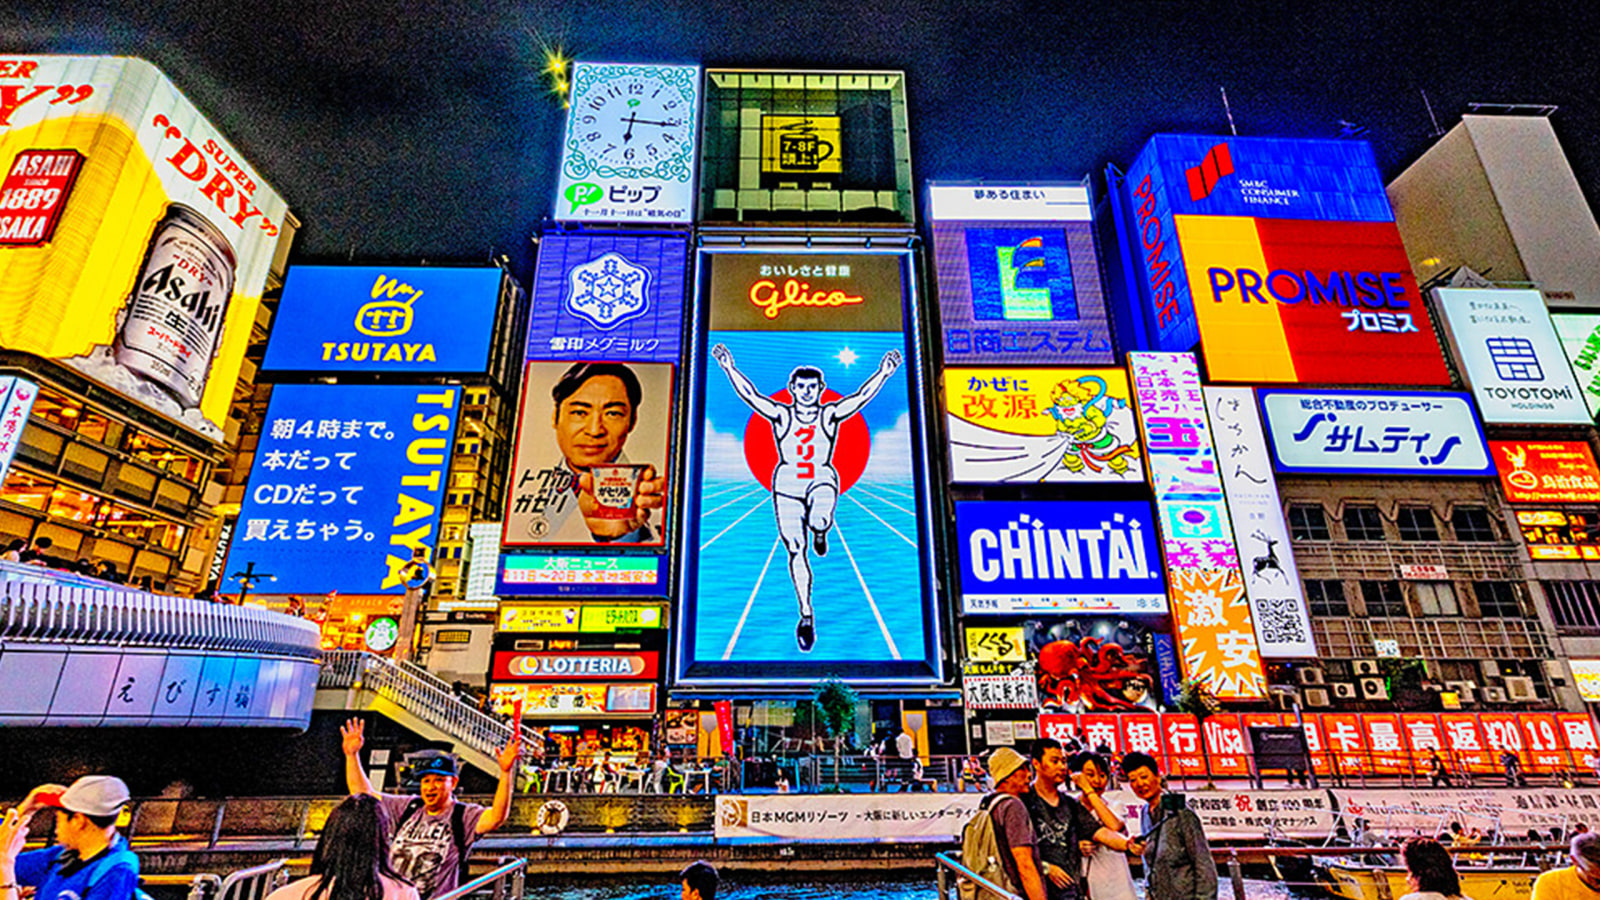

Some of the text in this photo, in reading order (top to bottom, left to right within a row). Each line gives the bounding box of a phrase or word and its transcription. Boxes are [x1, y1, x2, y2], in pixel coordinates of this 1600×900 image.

[607, 86, 622, 99] 11
[629, 84, 644, 95] 12
[588, 96, 606, 111] 10
[582, 115, 596, 124] 9
[586, 131, 602, 142] 8
[603, 143, 616, 154] 7
[623, 148, 635, 160] 6
[646, 143, 658, 156] 5
[782, 140, 817, 152] 7-8F
[11, 155, 76, 176] ASAHI
[203, 138, 258, 197] SUPER
[609, 185, 662, 204] ピップ
[1239, 180, 1269, 192] SMBC
[1240, 188, 1301, 199] CONSUMER
[0, 188, 61, 210] 1889
[1243, 197, 1292, 206] FINANCE
[1133, 174, 1181, 334] PROMISE
[760, 265, 851, 277] おいしさと健康
[1208, 266, 1412, 308] PROMISE
[142, 263, 221, 333] Asahi
[750, 279, 865, 319] Glico
[1340, 308, 1420, 334] プロミス
[548, 337, 660, 353] 雪印メグミルク
[947, 328, 1112, 354] 日商エステム
[322, 343, 438, 361] TSUTAYA
[967, 376, 1028, 392] かぜに
[961, 394, 1039, 419] 改源
[1299, 398, 1444, 412] 総合不動産のプロデューサー
[270, 417, 395, 441] 朝4時まで。
[794, 425, 817, 480] グリコ
[262, 450, 357, 476] 本だって
[253, 483, 364, 506] CDだって
[380, 388, 455, 590] TSUTAYA
[242, 518, 375, 542] 買えちゃう。
[209, 524, 233, 582] TSUTAYA
[544, 557, 618, 570] 大阪ニュース
[542, 656, 633, 674] LOTTERIA
[1234, 793, 1255, 812] 祝
[751, 811, 848, 827] 日本MGMリゾーツ
